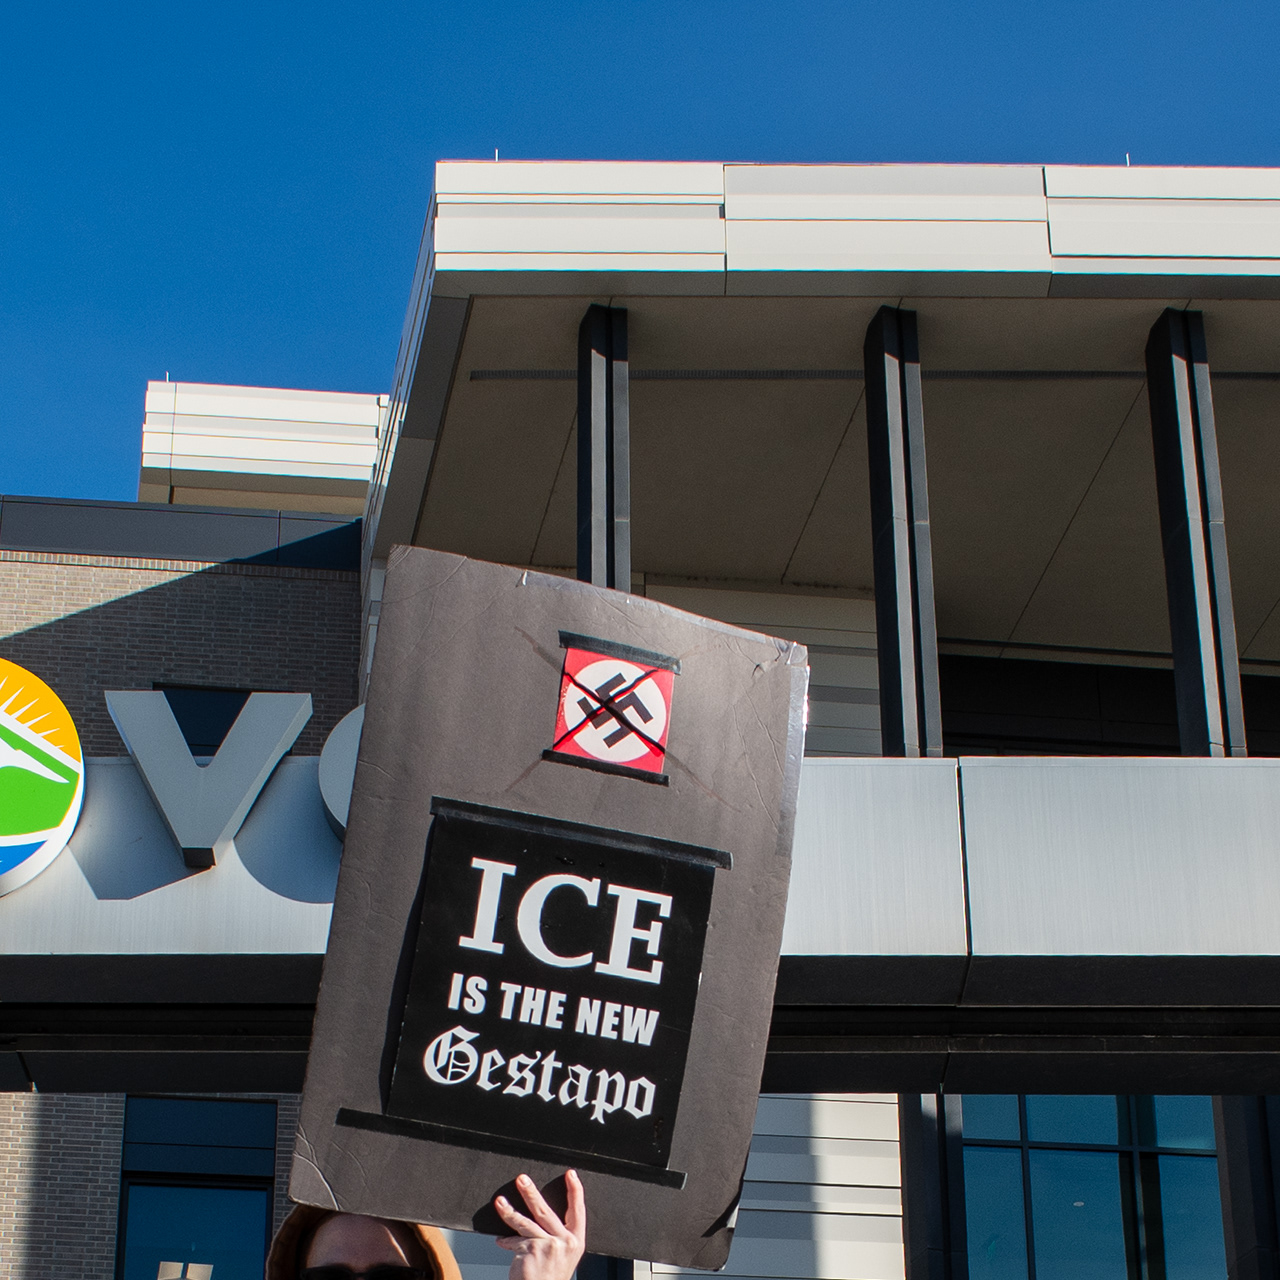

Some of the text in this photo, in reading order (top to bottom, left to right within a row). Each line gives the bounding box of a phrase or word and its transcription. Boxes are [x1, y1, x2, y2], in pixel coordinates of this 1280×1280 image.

[458, 857, 673, 984] ICE
[447, 972, 660, 1046] IS THE NEW
[422, 1025, 656, 1124] Gestapo
